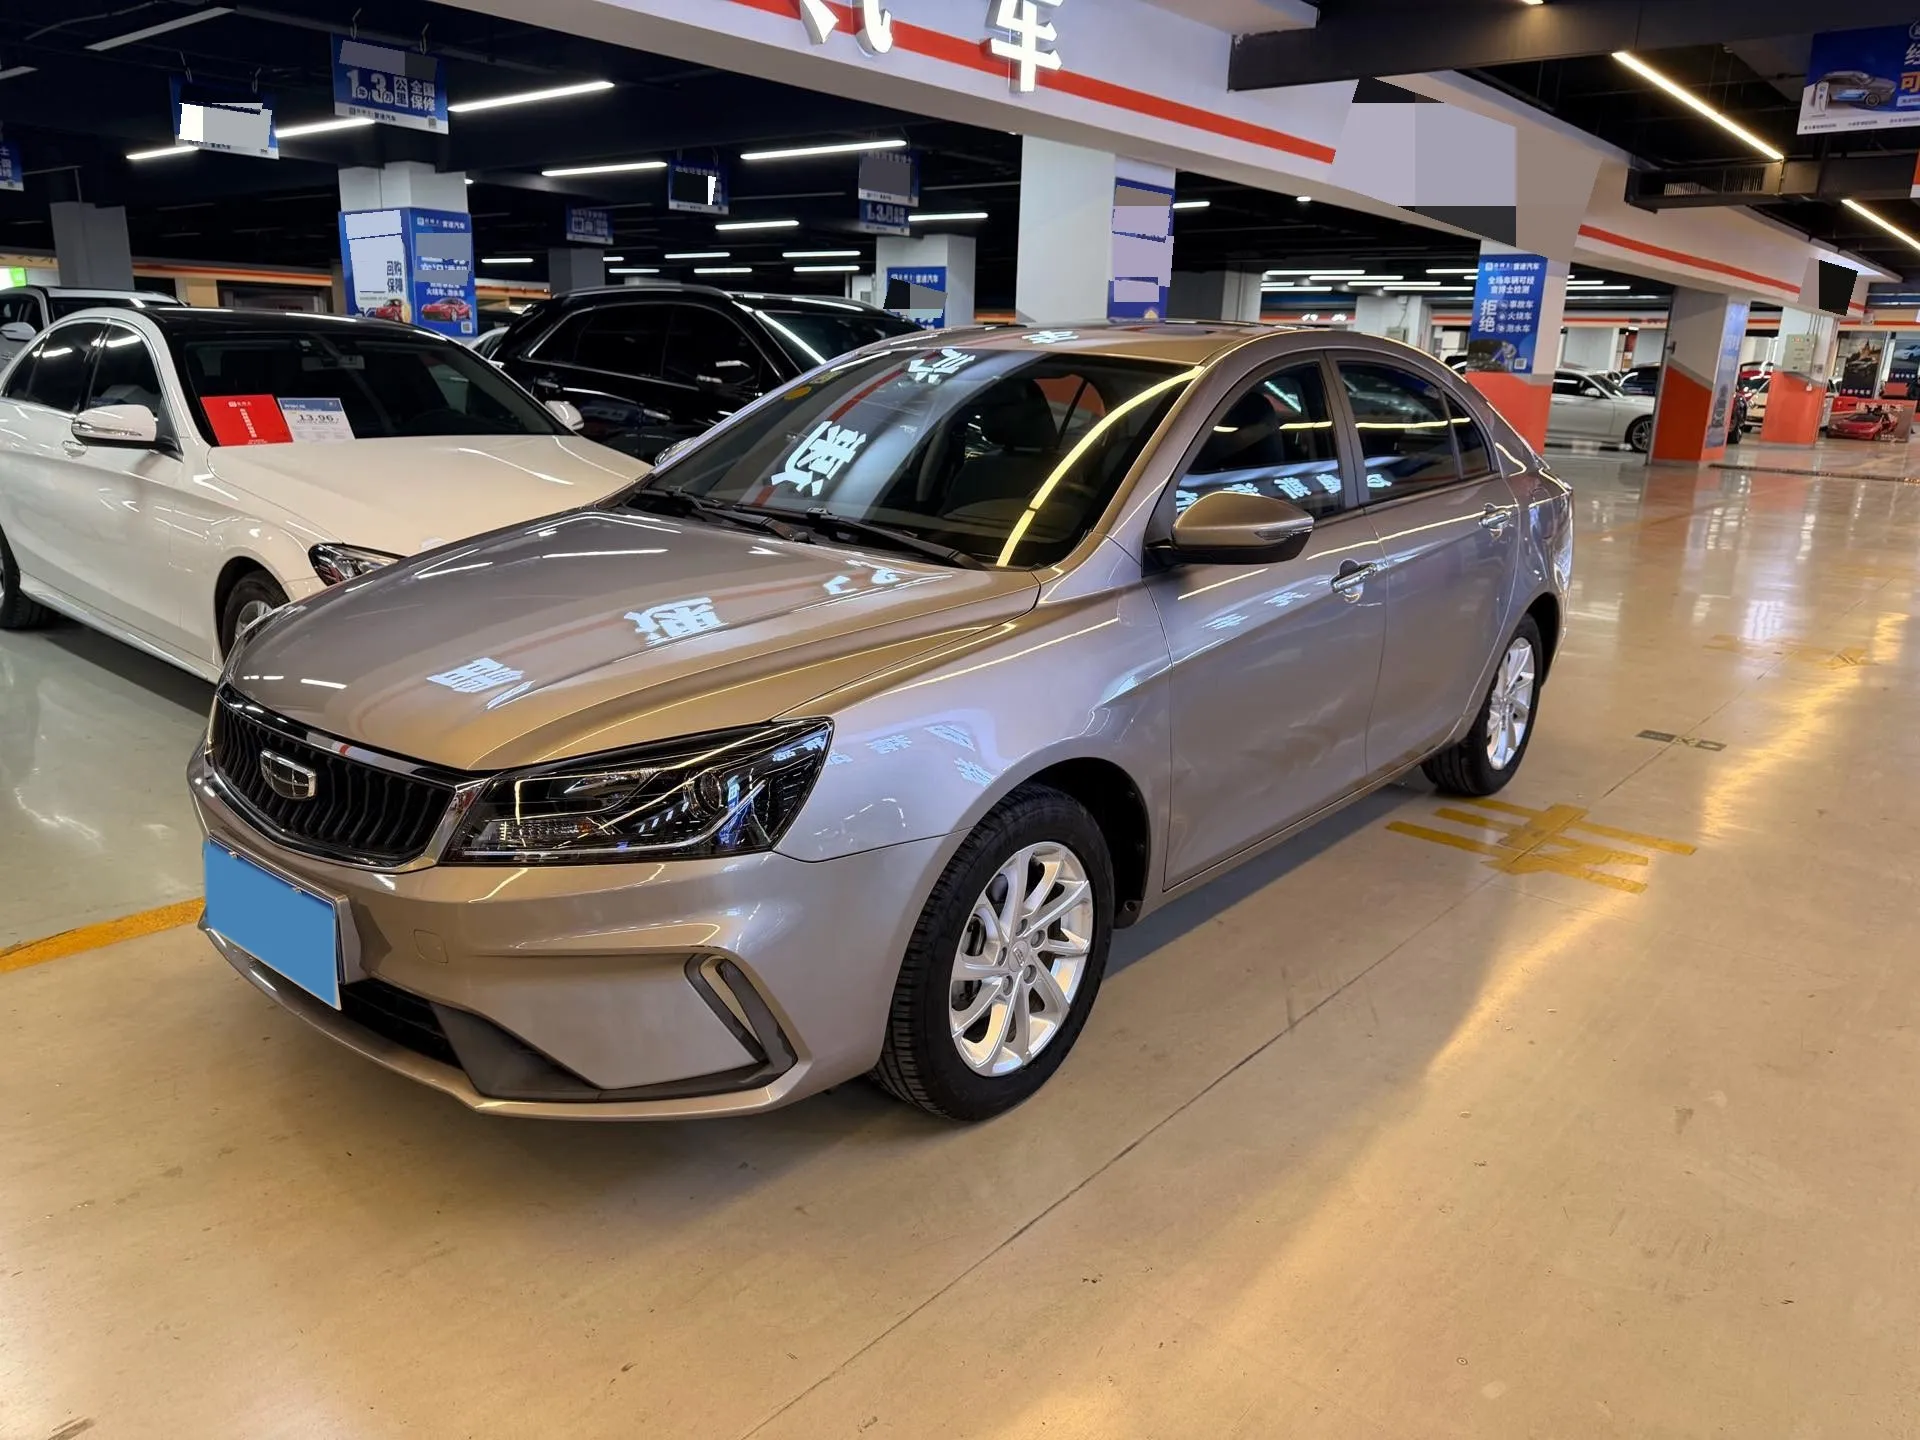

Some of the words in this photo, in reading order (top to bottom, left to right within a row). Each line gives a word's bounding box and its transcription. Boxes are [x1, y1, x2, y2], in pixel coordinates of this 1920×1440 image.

[410, 94, 436, 112] 保修
[1510, 300, 1534, 309] 事故车
[1478, 299, 1498, 333] 拒绝
[1507, 312, 1532, 320] 火烧车
